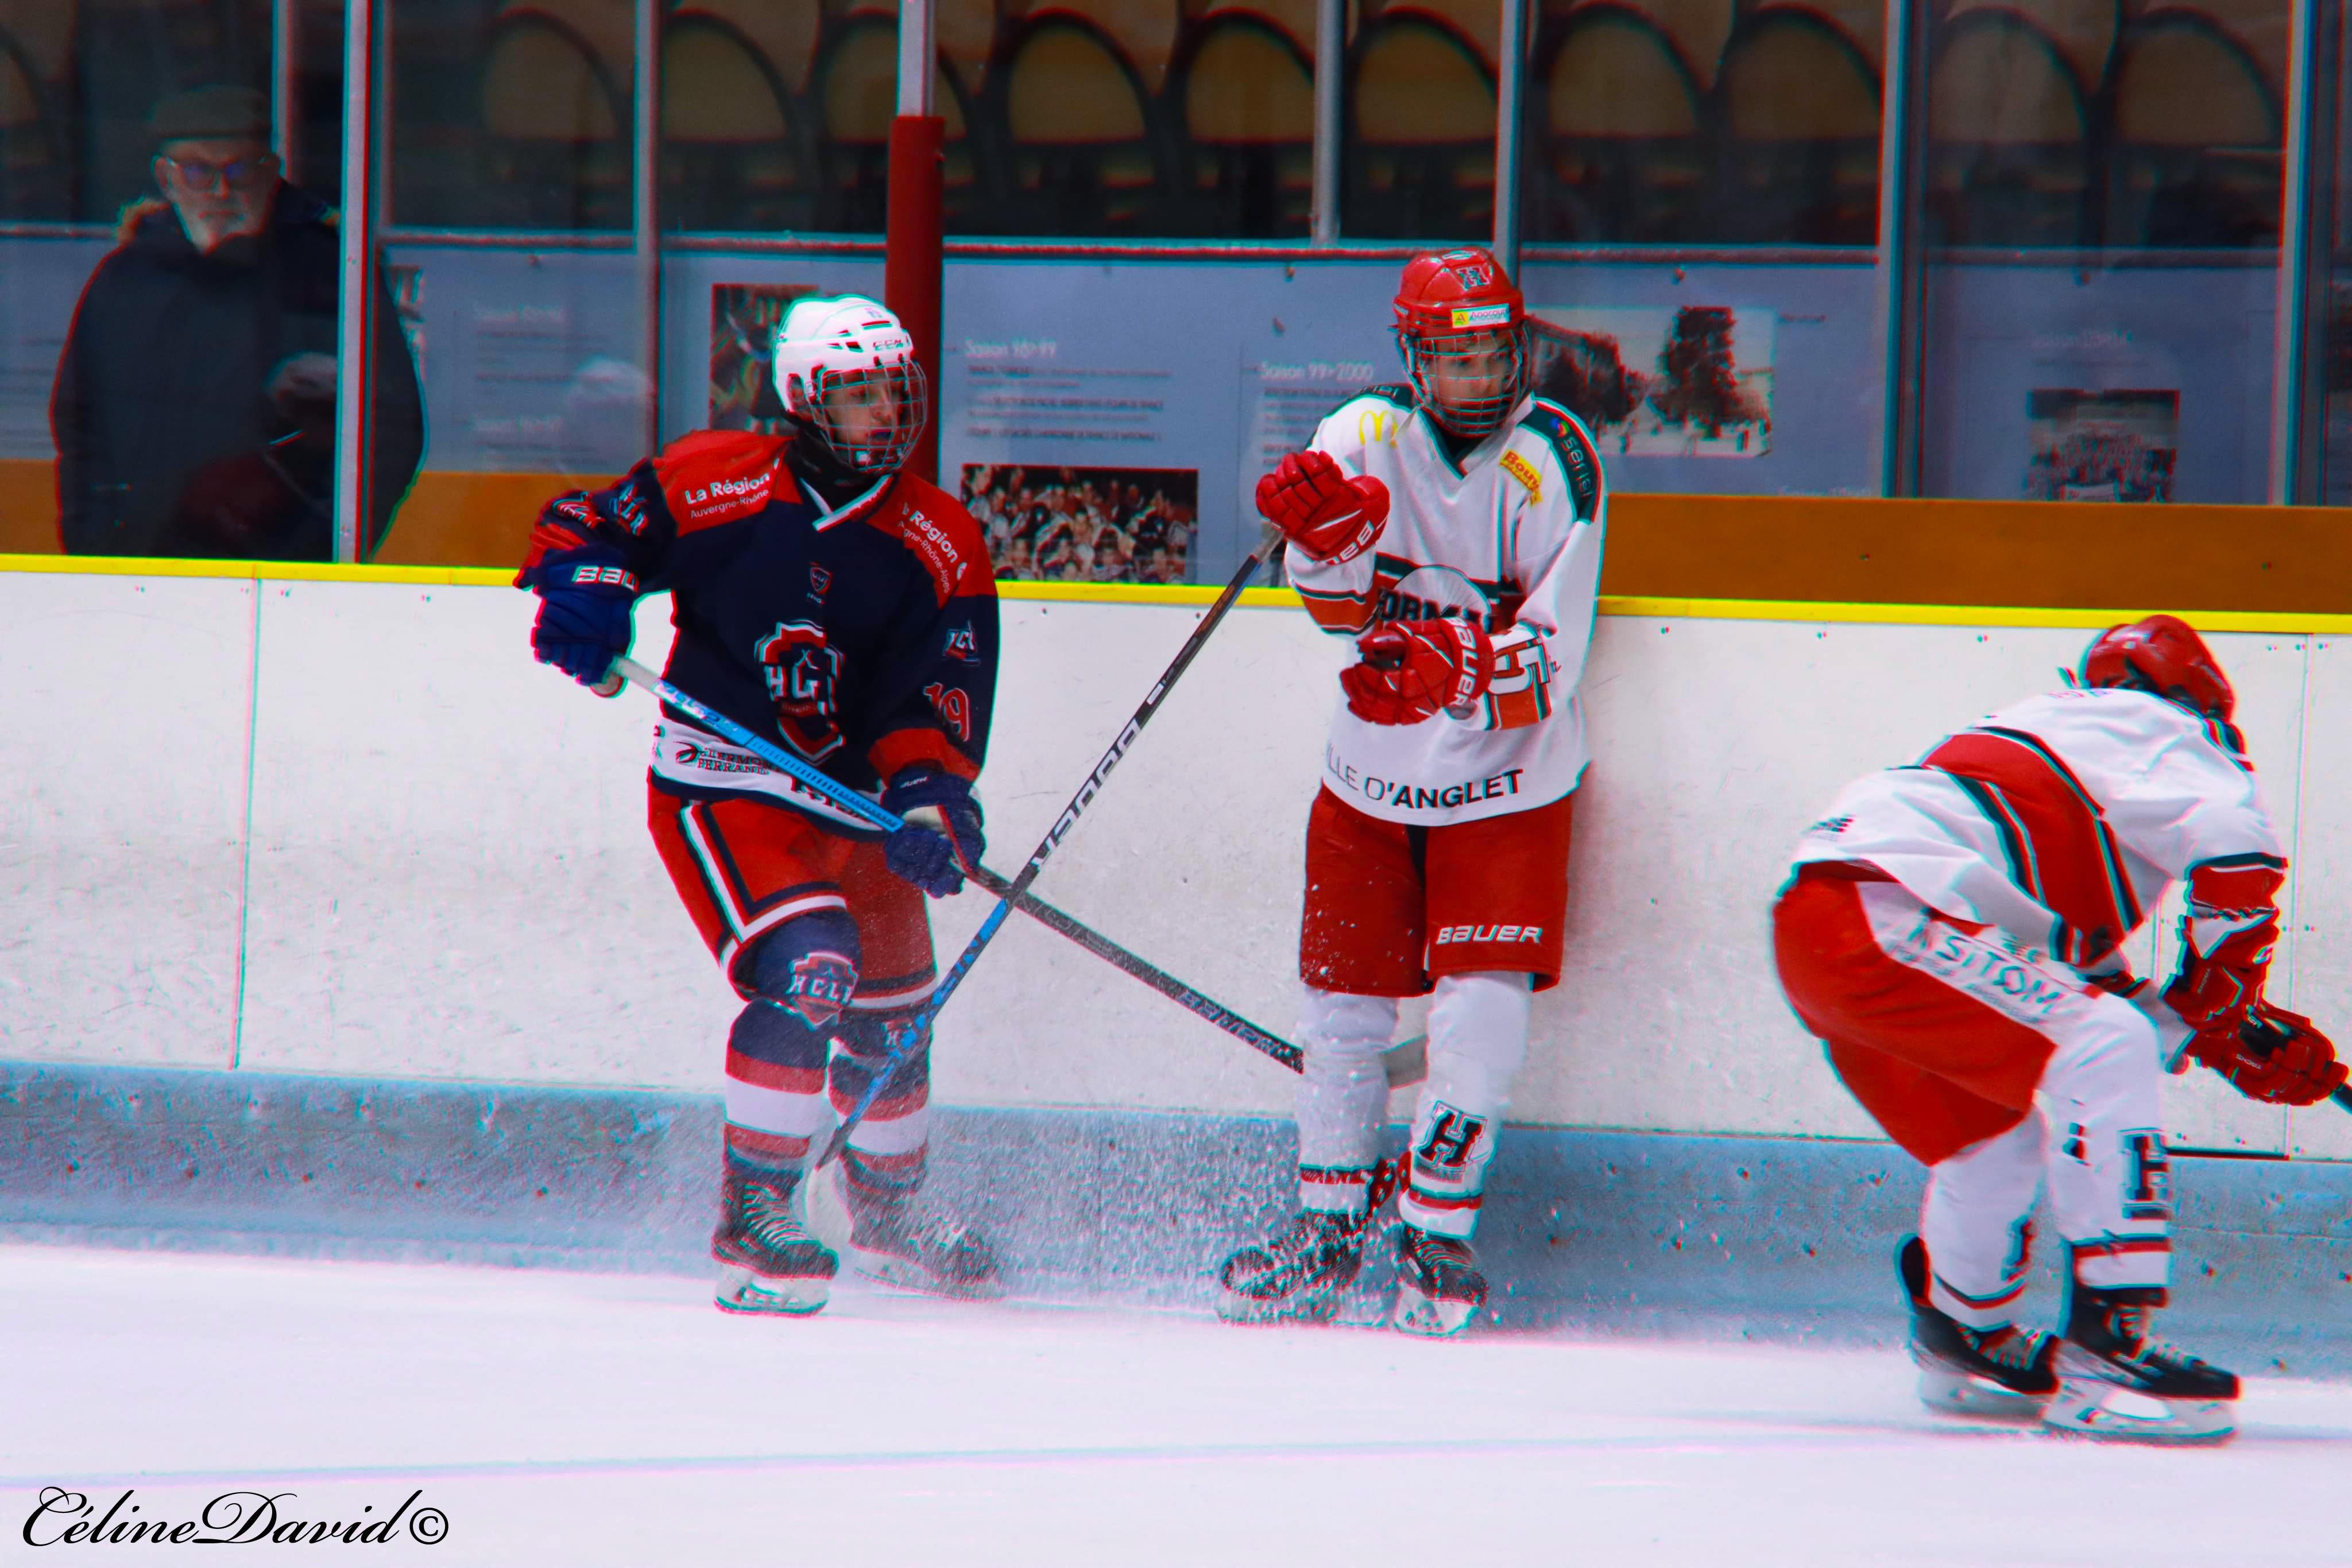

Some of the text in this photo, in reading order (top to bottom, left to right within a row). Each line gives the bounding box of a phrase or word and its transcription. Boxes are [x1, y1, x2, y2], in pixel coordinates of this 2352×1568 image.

[684, 472, 771, 505] La Région
[909, 510, 958, 564] Région
[1446, 616, 1479, 706] BAUER
[922, 681, 970, 742] 19
[1364, 768, 1525, 809] D'ANGLET
[1436, 924, 1544, 945] BAUER
[1418, 1101, 1488, 1171] H
